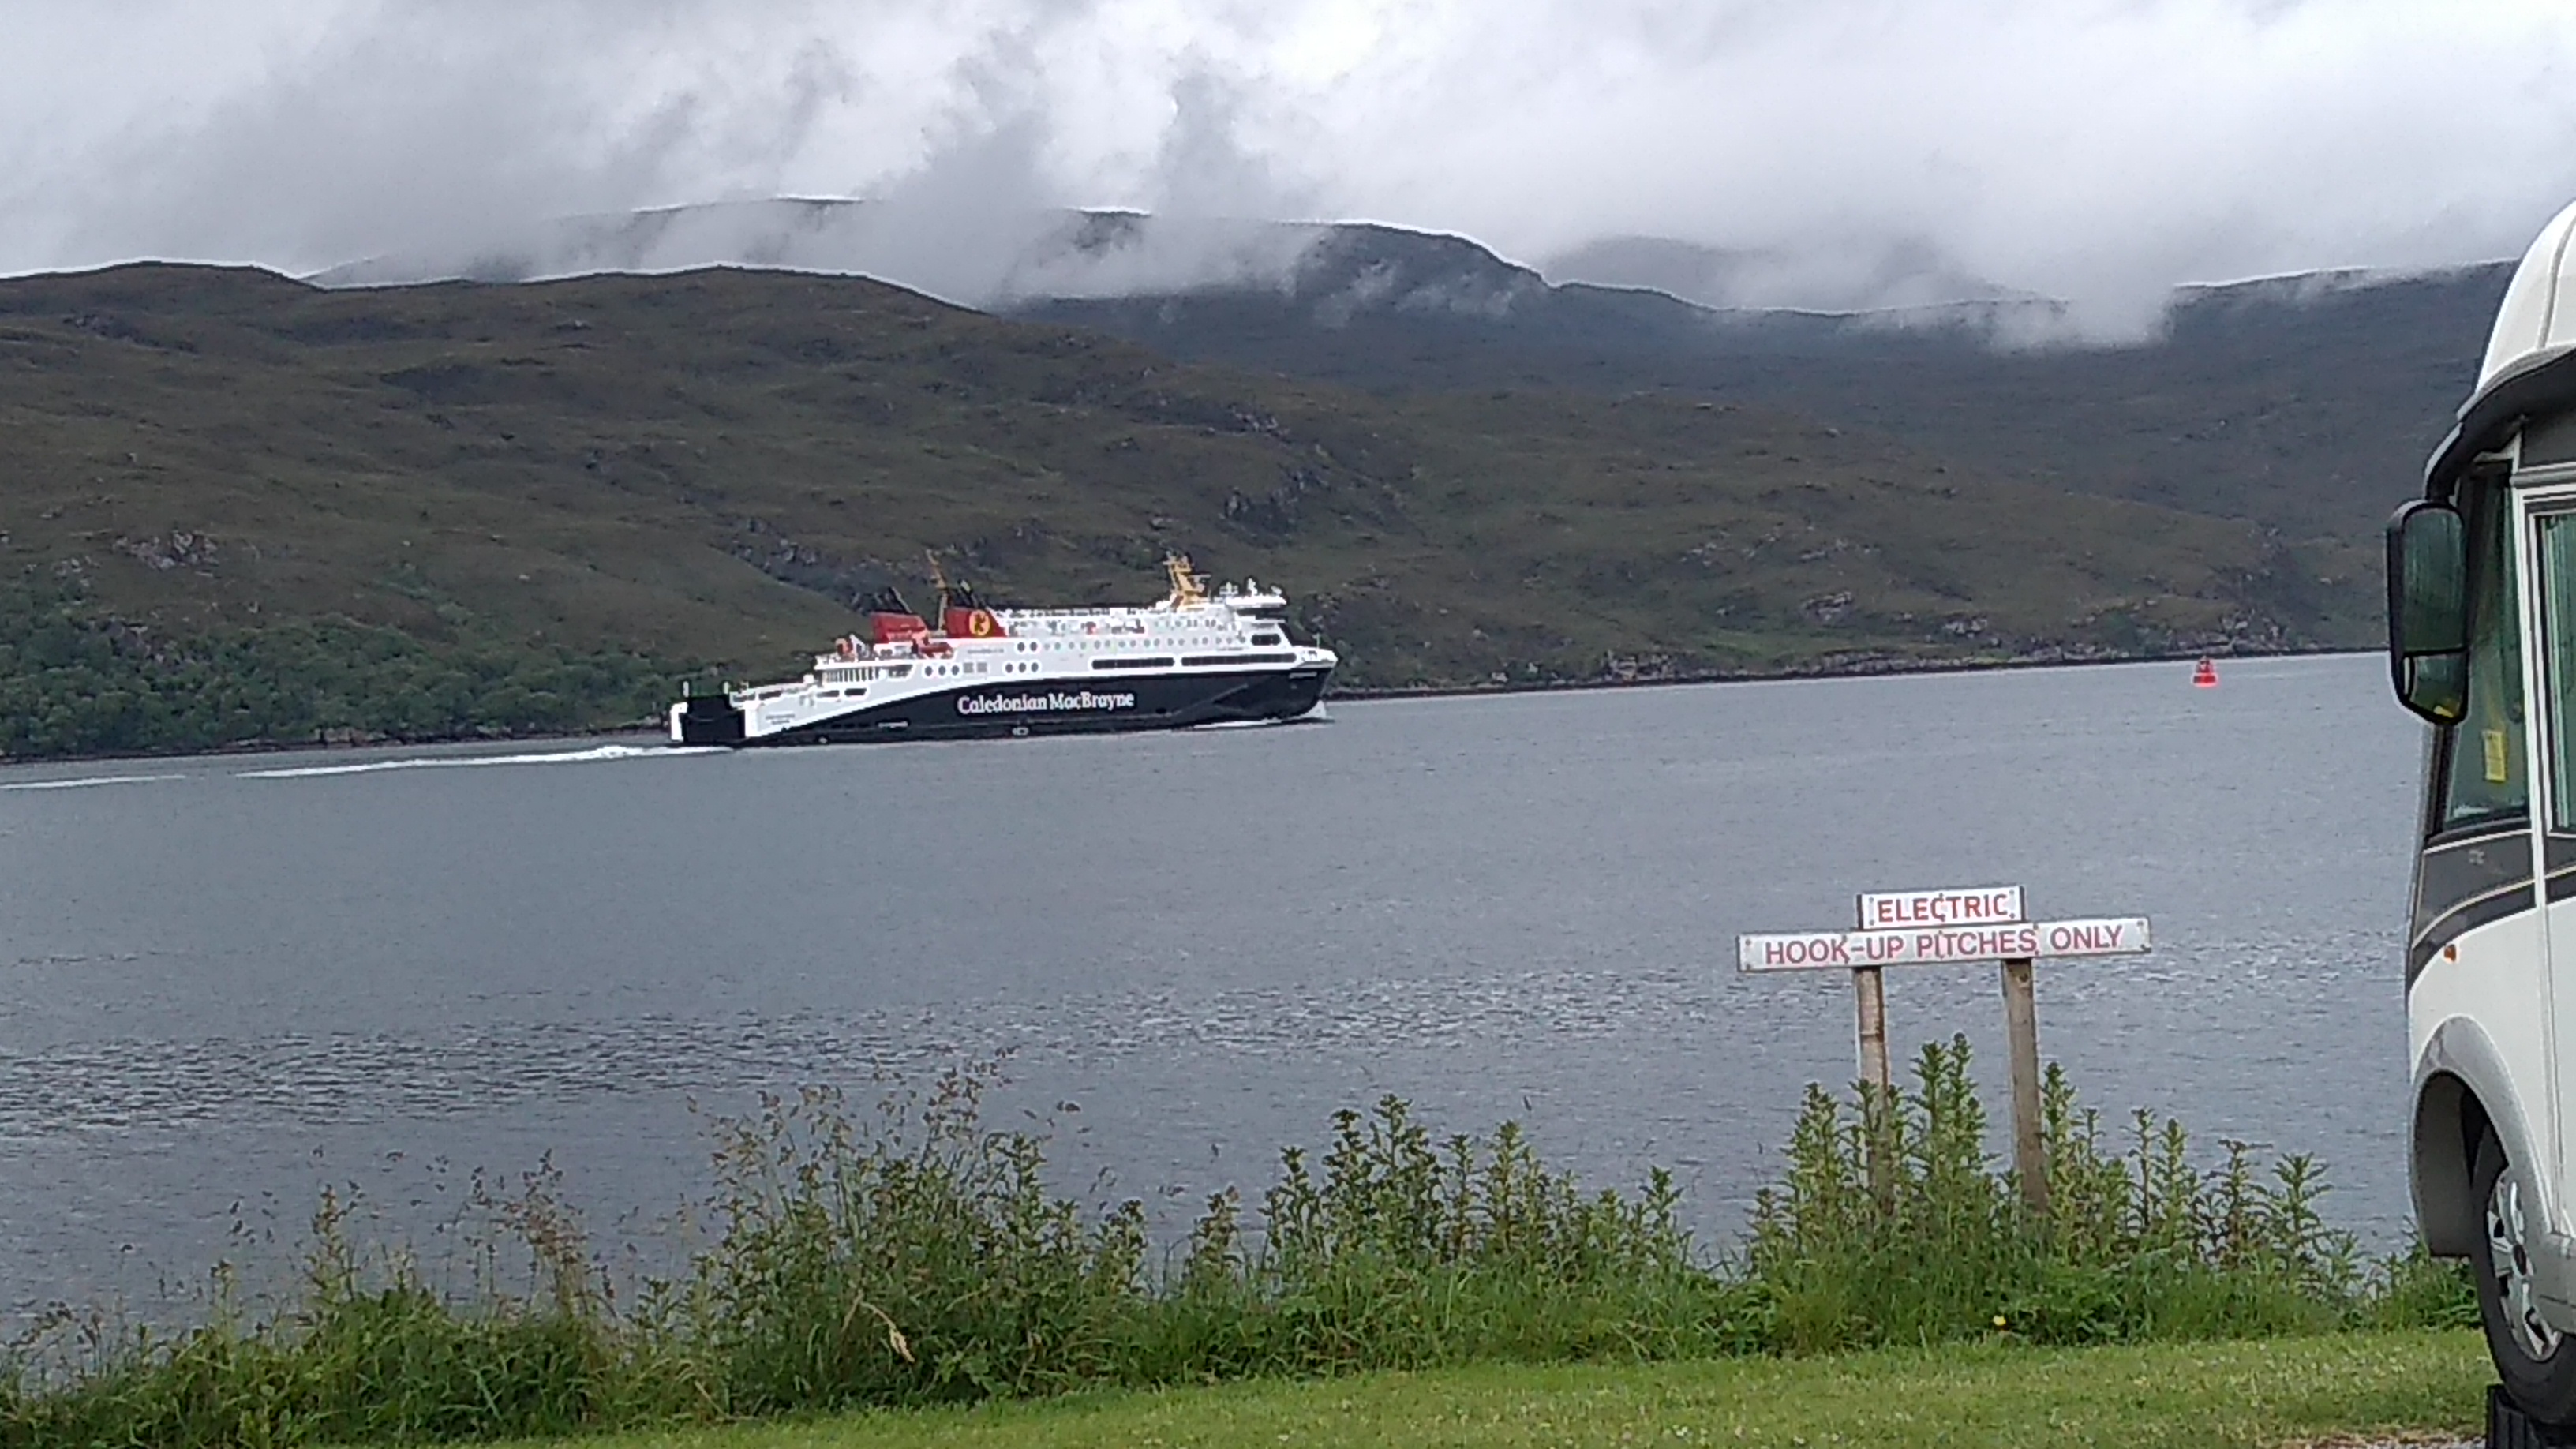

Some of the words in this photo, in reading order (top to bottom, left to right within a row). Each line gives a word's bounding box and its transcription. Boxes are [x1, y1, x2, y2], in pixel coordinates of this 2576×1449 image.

[957, 693, 1046, 714] Caledonian
[1048, 691, 1135, 710] MacBrayne
[1877, 893, 2008, 923] ELECTRIC
[1765, 936, 1904, 964] HOOK-UP
[1916, 929, 2038, 958] PITCHES
[2050, 924, 2123, 950] ONLY
